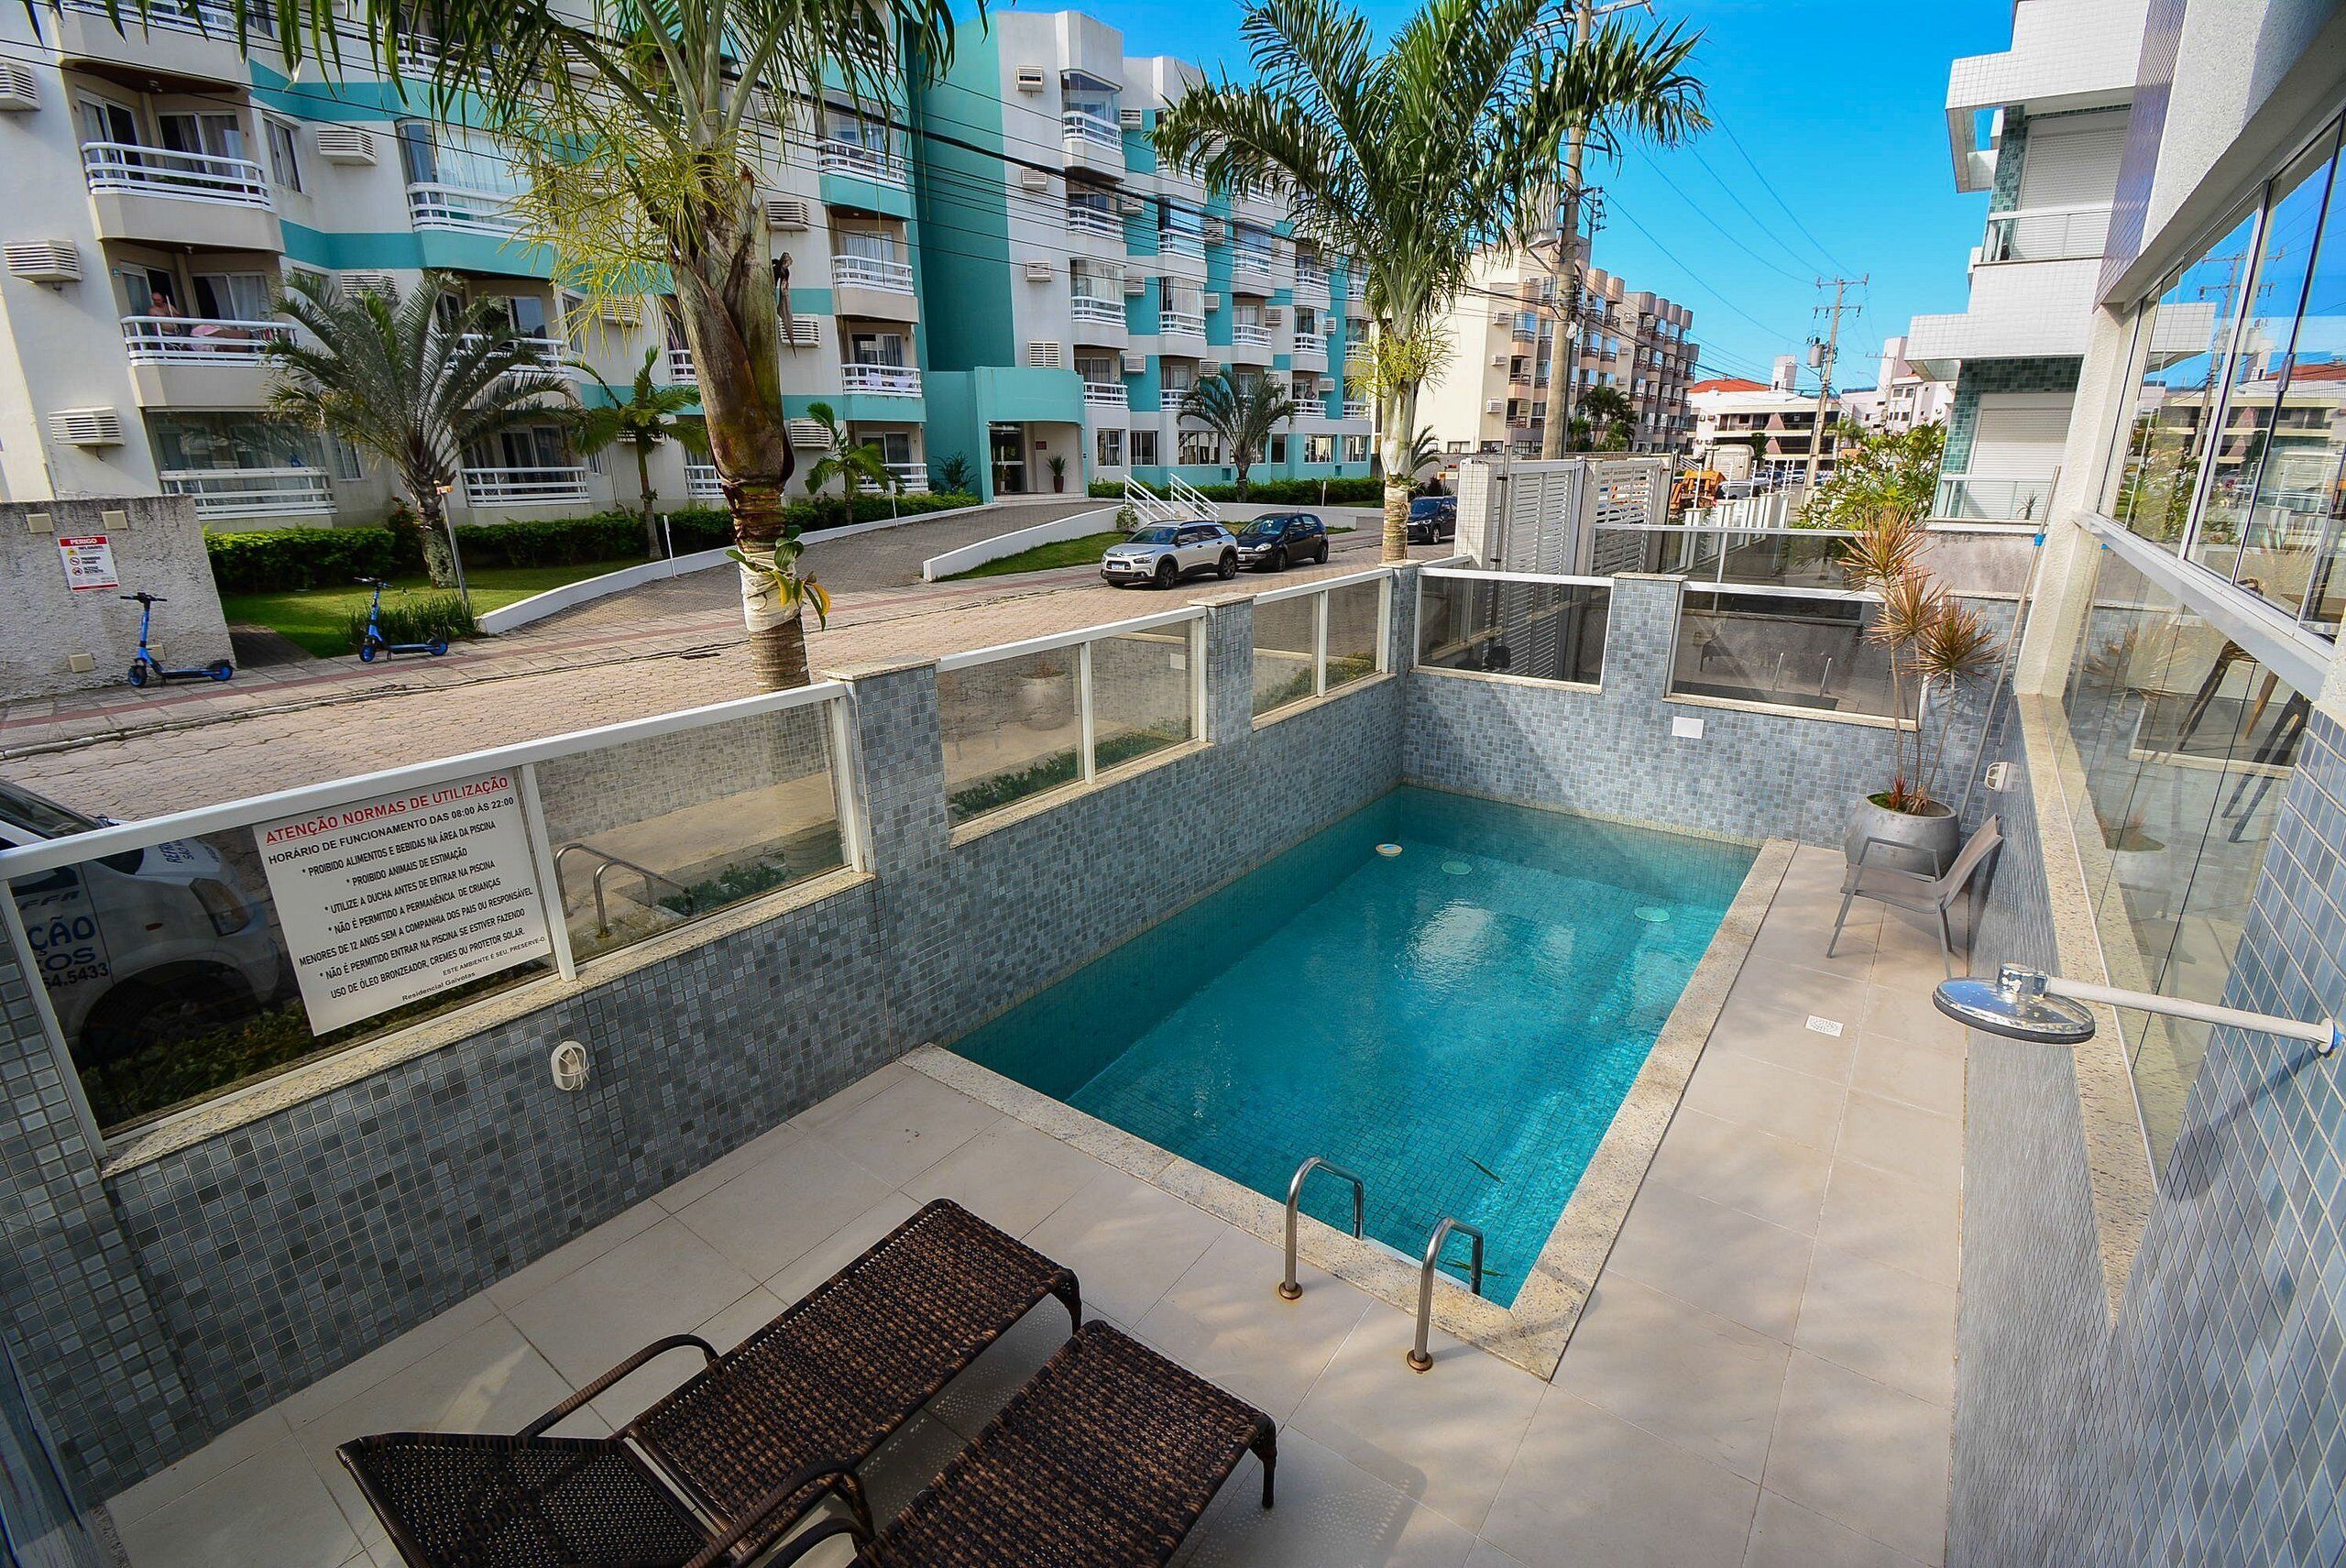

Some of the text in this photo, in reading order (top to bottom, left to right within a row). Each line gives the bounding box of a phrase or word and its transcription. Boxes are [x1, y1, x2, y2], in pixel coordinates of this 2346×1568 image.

[266, 776, 508, 844] ATENÇÃO NORMAS DE UTILIZAÇÃO
[268, 796, 514, 864] HORÁRIO DE FUNCIONAMENTO DAS 08:00 ÀS 22:00
[308, 820, 496, 876] PROIBIDO ALIMENTOS E BEBIDAS NA ÁREA DA PISCINA
[351, 846, 467, 886] PROIBIDO ANIMAIS DE ESTIMAÇÃO
[330, 860, 496, 914] UTILIZE A DUCHA ANTES DE ENTRAR NA PISCINA
[334, 877, 501, 935] NÃO É PERMITIDO A PERMANÊNCIA DE CRIANÇAS
[299, 887, 533, 967] MENORES DE 12 ANOS SEM A COMPANHIA DOS PAIS OU RESPONSÁVEL
[325, 908, 525, 980] NÃO É PERMITIDO ENTRAR NA PISCINA SE ESTIVER FAZENDO
[330, 987, 346, 999] USO
[347, 982, 359, 993] DE
[359, 975, 379, 990] ÓLEO
[430, 950, 458, 966] CREMES
[458, 946, 468, 956] OU
[469, 934, 502, 952] PROTETOR
[401, 971, 476, 1001] Residencial Gaivotas
[443, 967, 458, 976] ESTE
[459, 956, 489, 970] AMBIENTE
